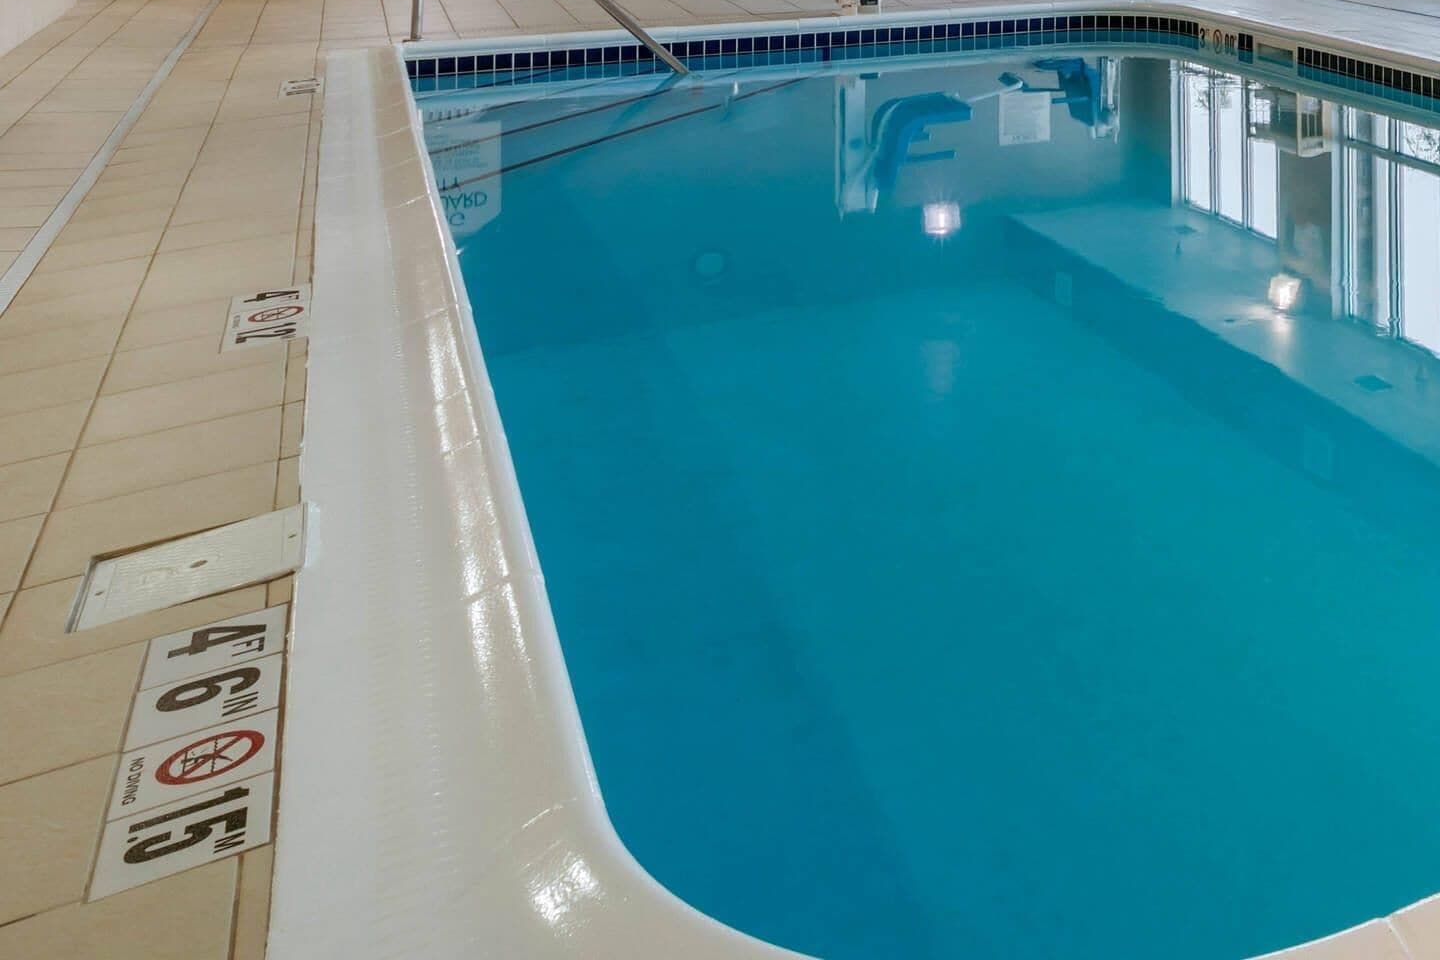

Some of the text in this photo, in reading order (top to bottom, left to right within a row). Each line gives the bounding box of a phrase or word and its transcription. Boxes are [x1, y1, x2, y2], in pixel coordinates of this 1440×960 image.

[168, 624, 267, 659] 4
[232, 637, 265, 657] FT
[156, 667, 261, 712] 6
[222, 691, 259, 717] IN
[121, 757, 144, 806] NO DIVING
[213, 831, 246, 854] M
